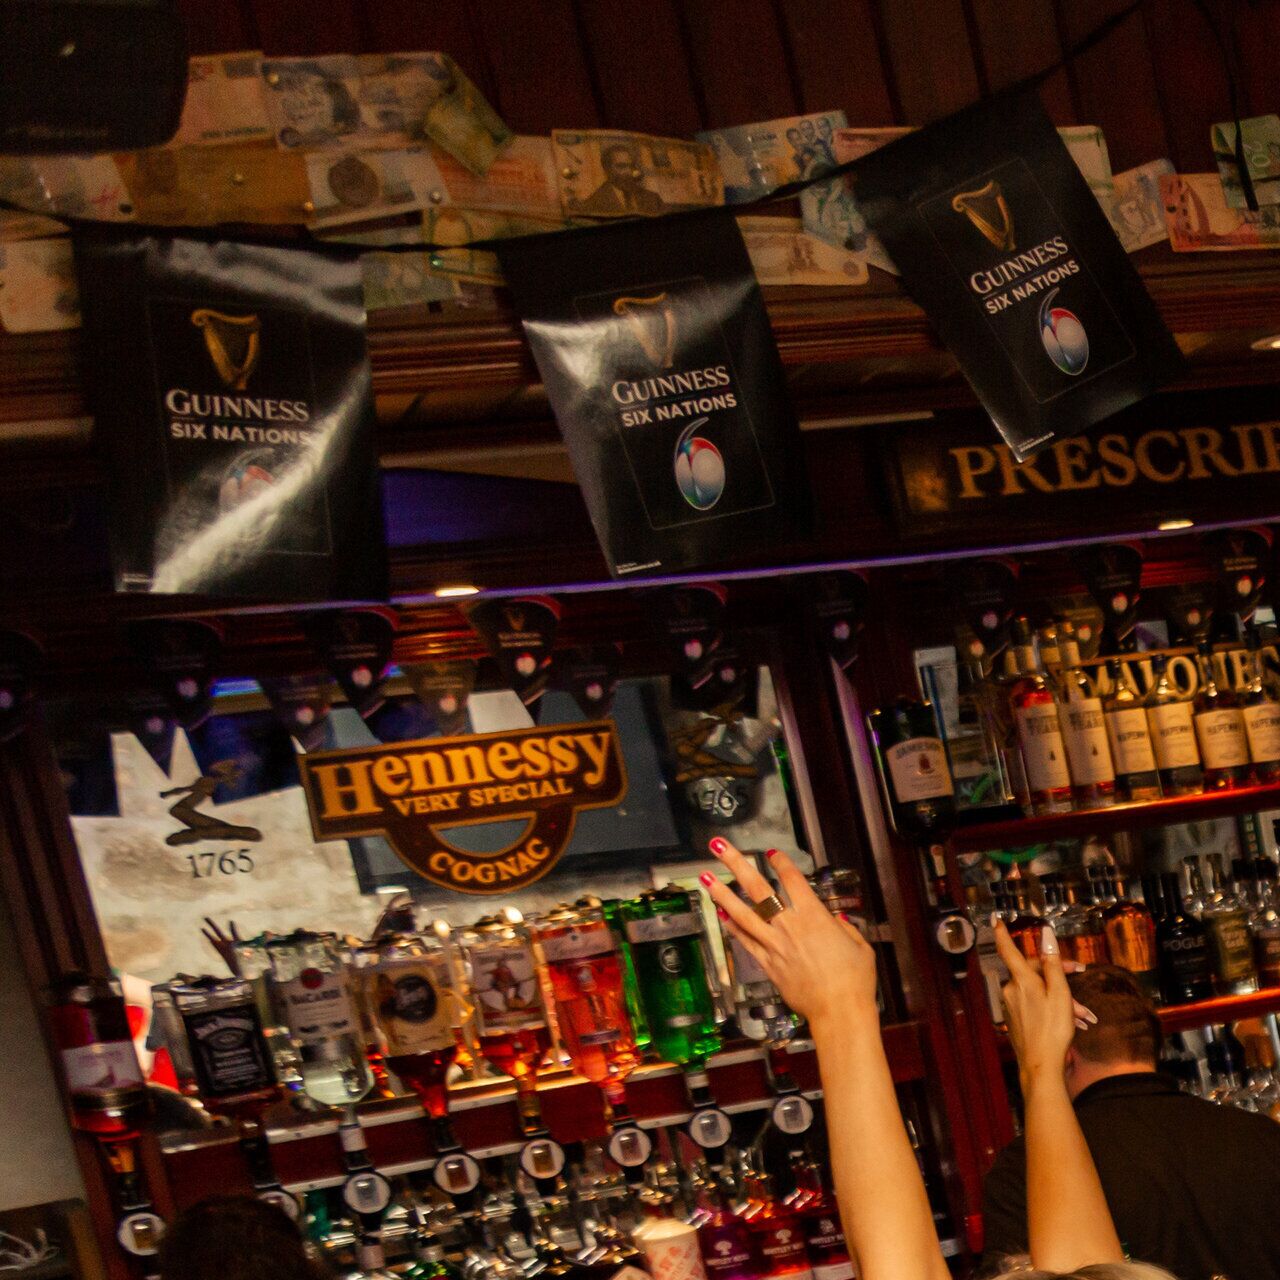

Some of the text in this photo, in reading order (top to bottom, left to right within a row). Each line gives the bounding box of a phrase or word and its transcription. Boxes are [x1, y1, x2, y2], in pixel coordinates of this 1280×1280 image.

[970, 236, 1069, 294] GUINNESS
[984, 259, 1081, 315] SIX NATIONS
[611, 364, 732, 405] GUINNESS
[165, 387, 311, 423] GUINNESS
[621, 391, 738, 429] SIX NATIONS
[170, 421, 314, 449] SIX NATIONS
[310, 731, 612, 819] Hennessy
[389, 778, 575, 818] VERY SPECIAL
[186, 848, 255, 879] 1765
[429, 837, 551, 884] COGNAC
